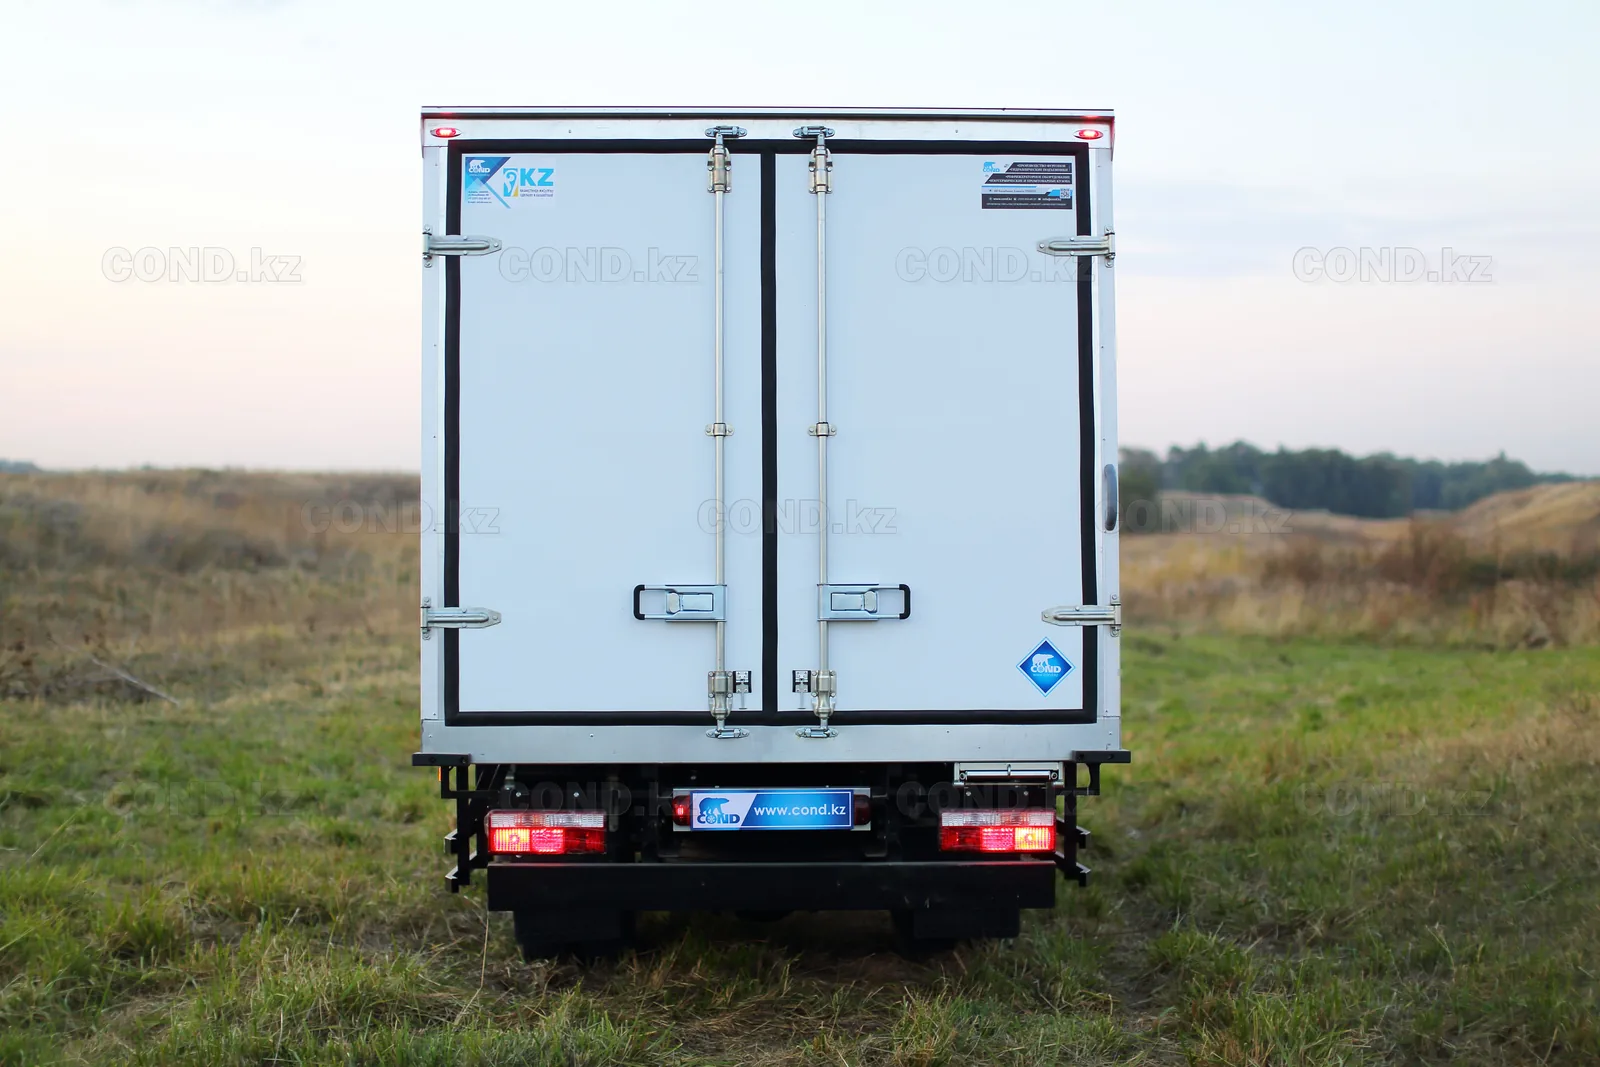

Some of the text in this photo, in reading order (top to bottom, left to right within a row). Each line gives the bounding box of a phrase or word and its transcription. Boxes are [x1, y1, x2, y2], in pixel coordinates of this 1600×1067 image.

[520, 168, 554, 186] KZ
[1030, 665, 1061, 673] COND
[754, 804, 846, 816] www.cond.kz
[697, 814, 740, 824] COND
